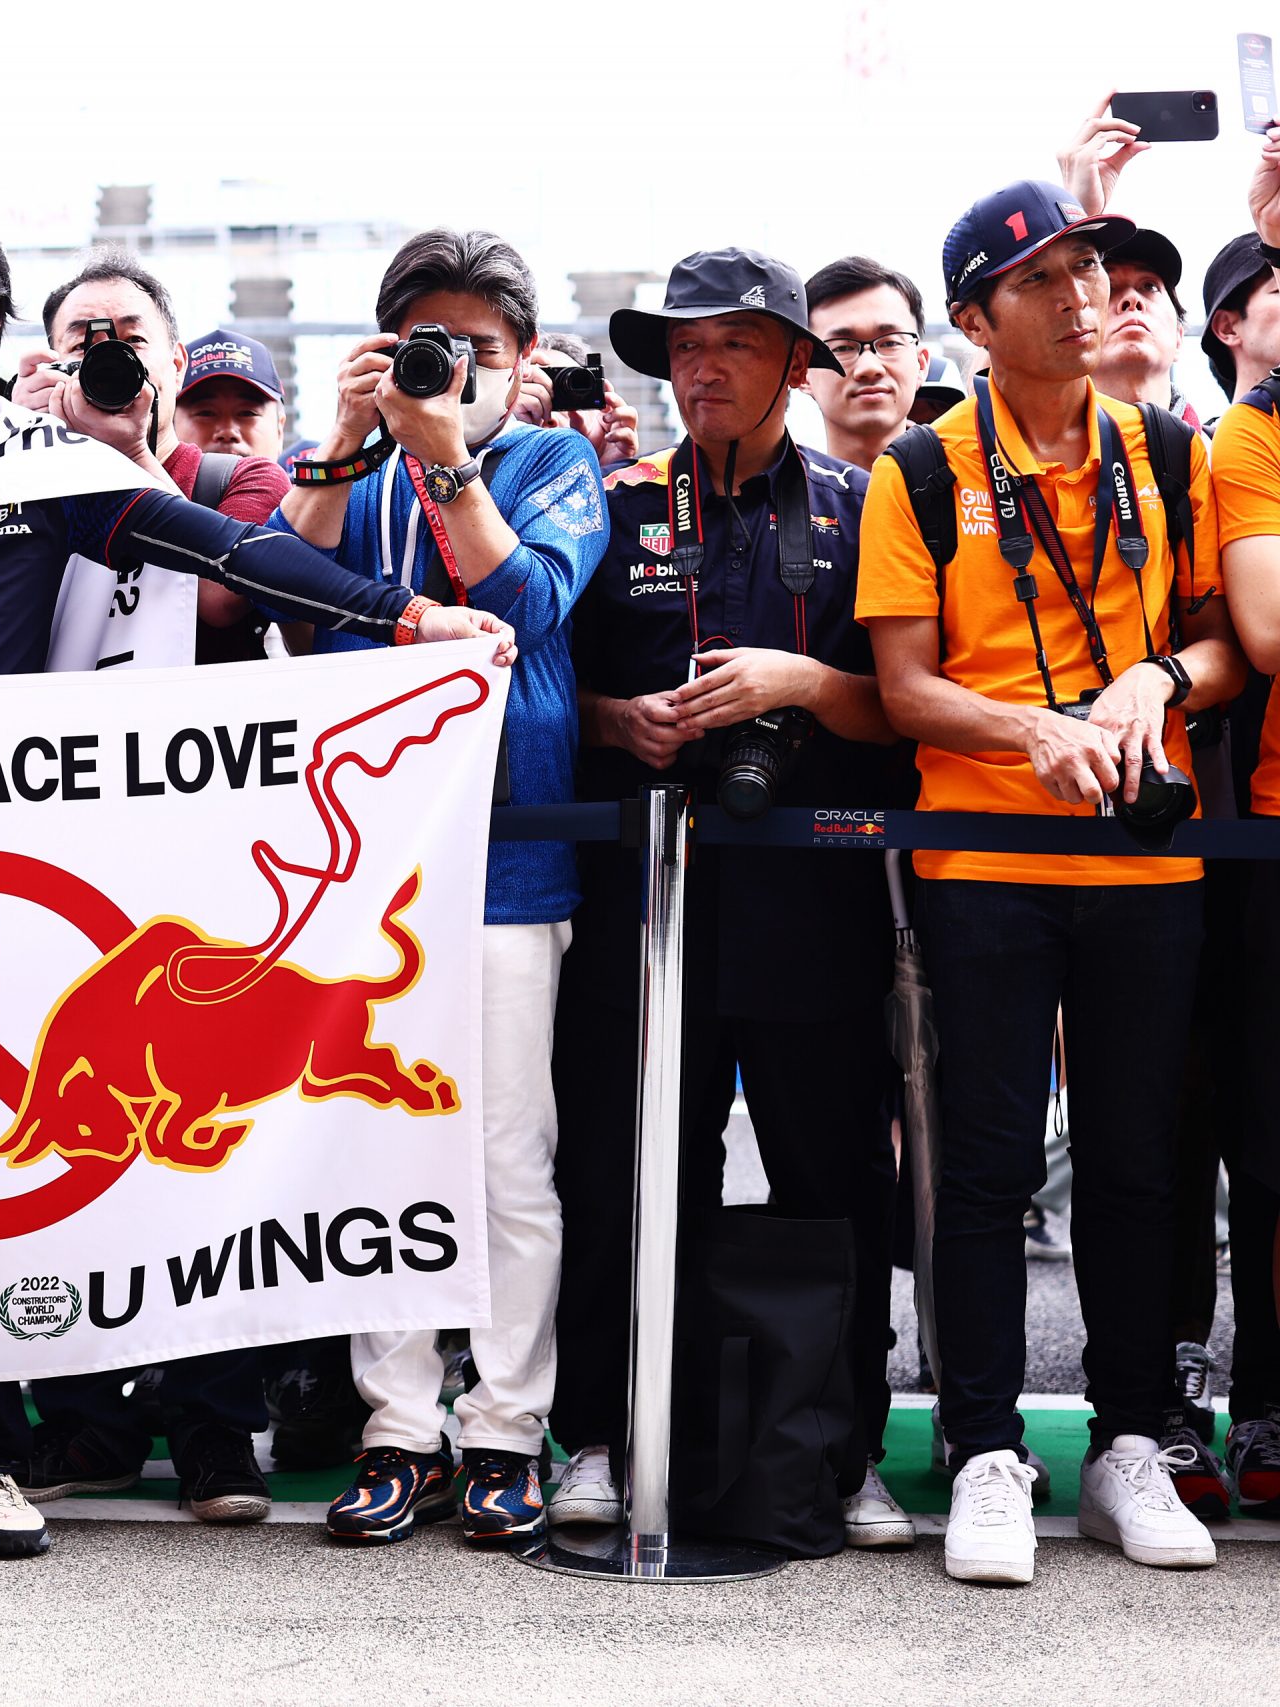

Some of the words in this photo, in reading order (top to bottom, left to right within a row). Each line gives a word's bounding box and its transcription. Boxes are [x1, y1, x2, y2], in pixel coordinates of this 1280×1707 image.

[1004, 211, 1029, 241] 1
[191, 342, 252, 359] ORACLE
[191, 354, 207, 368] Red
[207, 352, 224, 361] Bull
[191, 362, 254, 376] RACING
[990, 453, 1011, 493] EOS
[960, 488, 992, 506] GIV
[1112, 462, 1132, 520] Canon
[676, 473, 691, 532] Canon
[999, 497, 1016, 519] 7D
[644, 526, 671, 536] TA
[643, 538, 669, 553] HEU
[755, 717, 779, 730] Canon
[125, 719, 298, 797] LOVE
[814, 810, 885, 822] ORACLE
[814, 823, 833, 833] Red
[834, 823, 853, 833] Bull
[813, 837, 885, 845] RACING
[166, 1201, 459, 1308] WINGS
[21, 1276, 60, 1292] 2022
[24, 1304, 55, 1315] WORLD
[17, 1314, 62, 1326] CHAMPION
